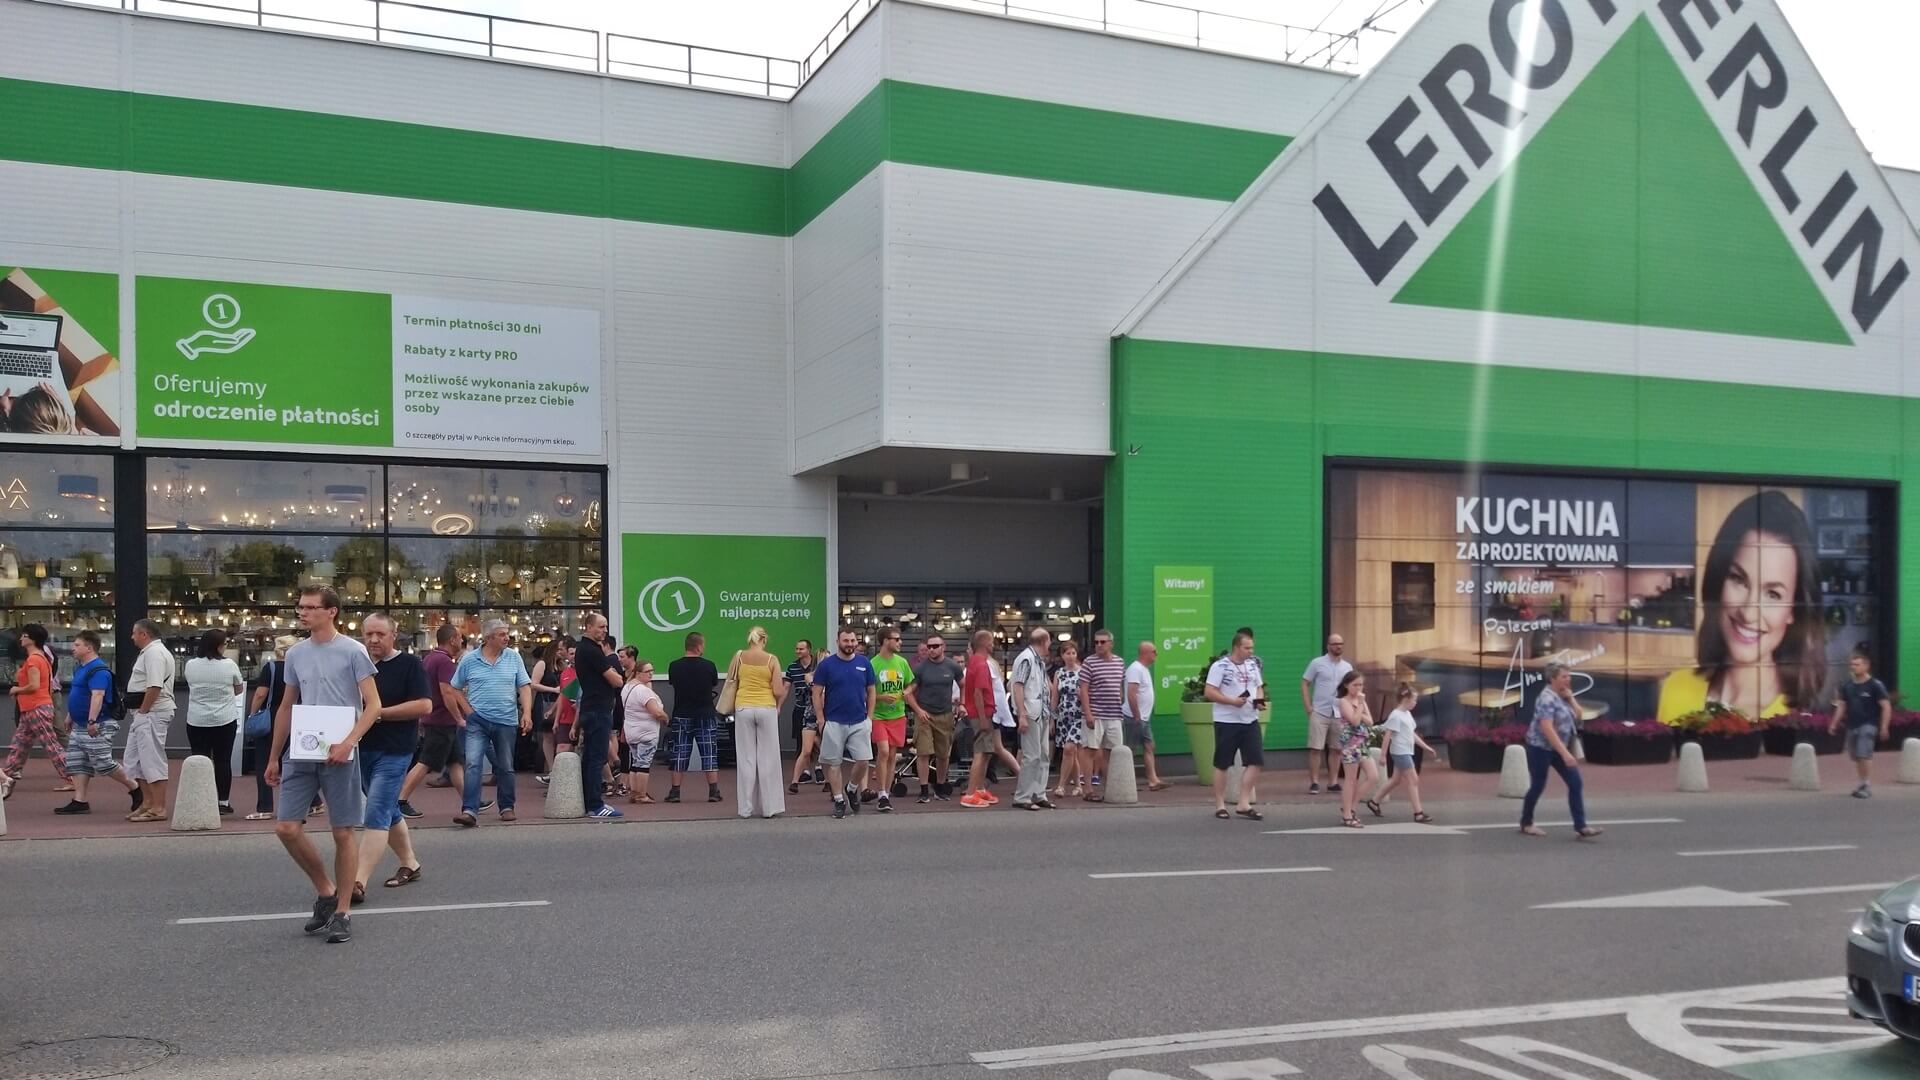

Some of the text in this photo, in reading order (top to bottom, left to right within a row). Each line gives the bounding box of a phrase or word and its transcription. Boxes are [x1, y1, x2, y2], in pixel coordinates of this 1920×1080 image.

[1312, 0, 1618, 286] LERO
[1656, 0, 1910, 333] ERLIN
[215, 302, 228, 320] 1
[403, 315, 542, 334] Termin płatności 30 dni
[404, 344, 518, 361] Rabaty z karty PRO
[154, 374, 267, 400] Oferujemy
[404, 373, 590, 395] Możliwość wykonania zakupów
[404, 389, 575, 407] przez wskazane przez Ciebie
[154, 400, 380, 427] odroczenie płatności
[404, 402, 440, 416] osoby
[405, 431, 411, 439] O
[412, 432, 447, 441] szczegóły
[447, 433, 465, 442] pytaj
[474, 435, 501, 443] Punkcie
[553, 438, 577, 447] sklepu.
[1456, 496, 1620, 537] KUCHNIA
[1456, 541, 1619, 562] ZAPROJEKTOWANA
[1163, 578, 1205, 591] Witamy!
[1456, 575, 1554, 594] ze smakiem
[670, 590, 691, 616] 1
[719, 590, 810, 605] Gwarantujemy
[719, 606, 811, 620] najlepszą cenę
[1483, 617, 1552, 636] Polecam
